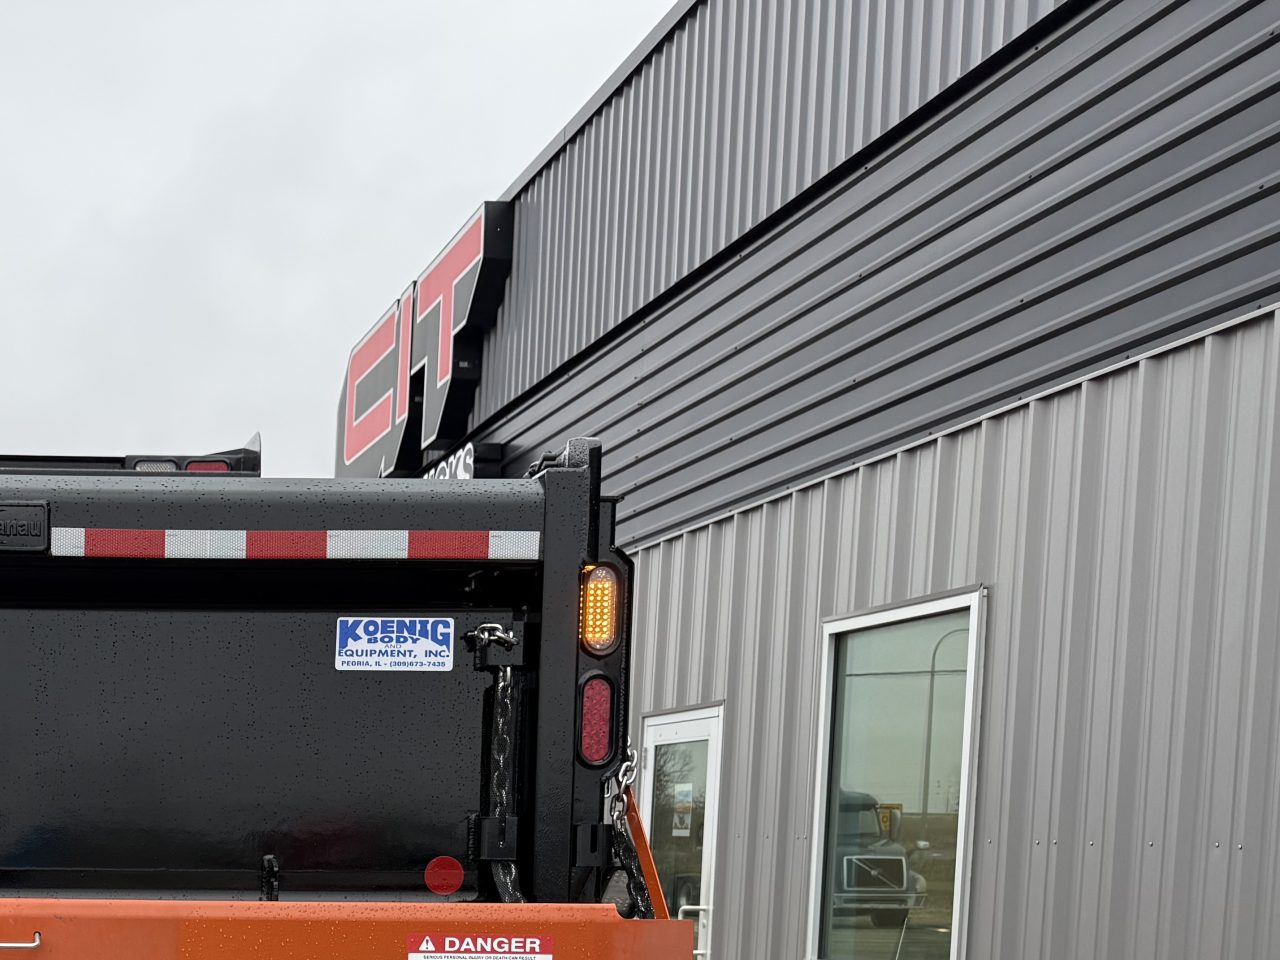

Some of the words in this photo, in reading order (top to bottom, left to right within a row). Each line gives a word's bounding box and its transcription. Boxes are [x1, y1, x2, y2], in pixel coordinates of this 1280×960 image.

[343, 213, 484, 466] CIT
[338, 619, 451, 653] KOENIG
[367, 635, 420, 644] BODY
[338, 649, 417, 659] EQUIPMENT,
[424, 650, 450, 658] INC.
[444, 937, 541, 953] DANGER
